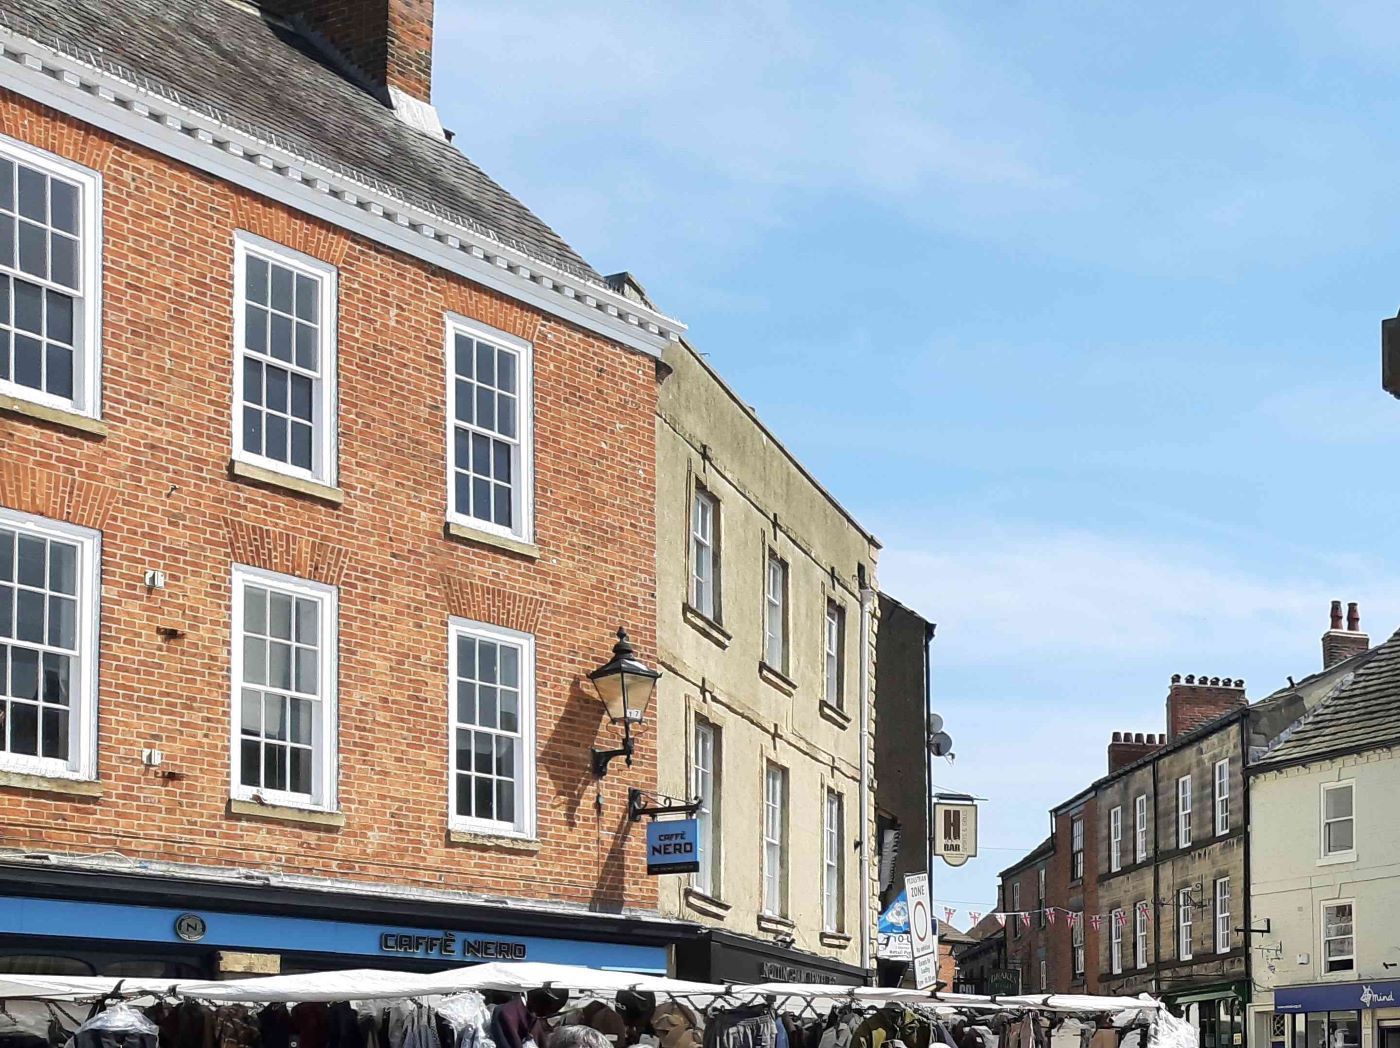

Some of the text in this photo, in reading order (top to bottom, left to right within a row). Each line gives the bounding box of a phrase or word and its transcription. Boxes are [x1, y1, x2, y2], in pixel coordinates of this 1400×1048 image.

[658, 831, 686, 842] CAFFÈ
[652, 842, 693, 856] NERO
[944, 844, 960, 852] BAR
[910, 886, 925, 897] ZONE
[381, 932, 528, 960] CAFFÈ NERO
[1372, 991, 1395, 1001] mind
